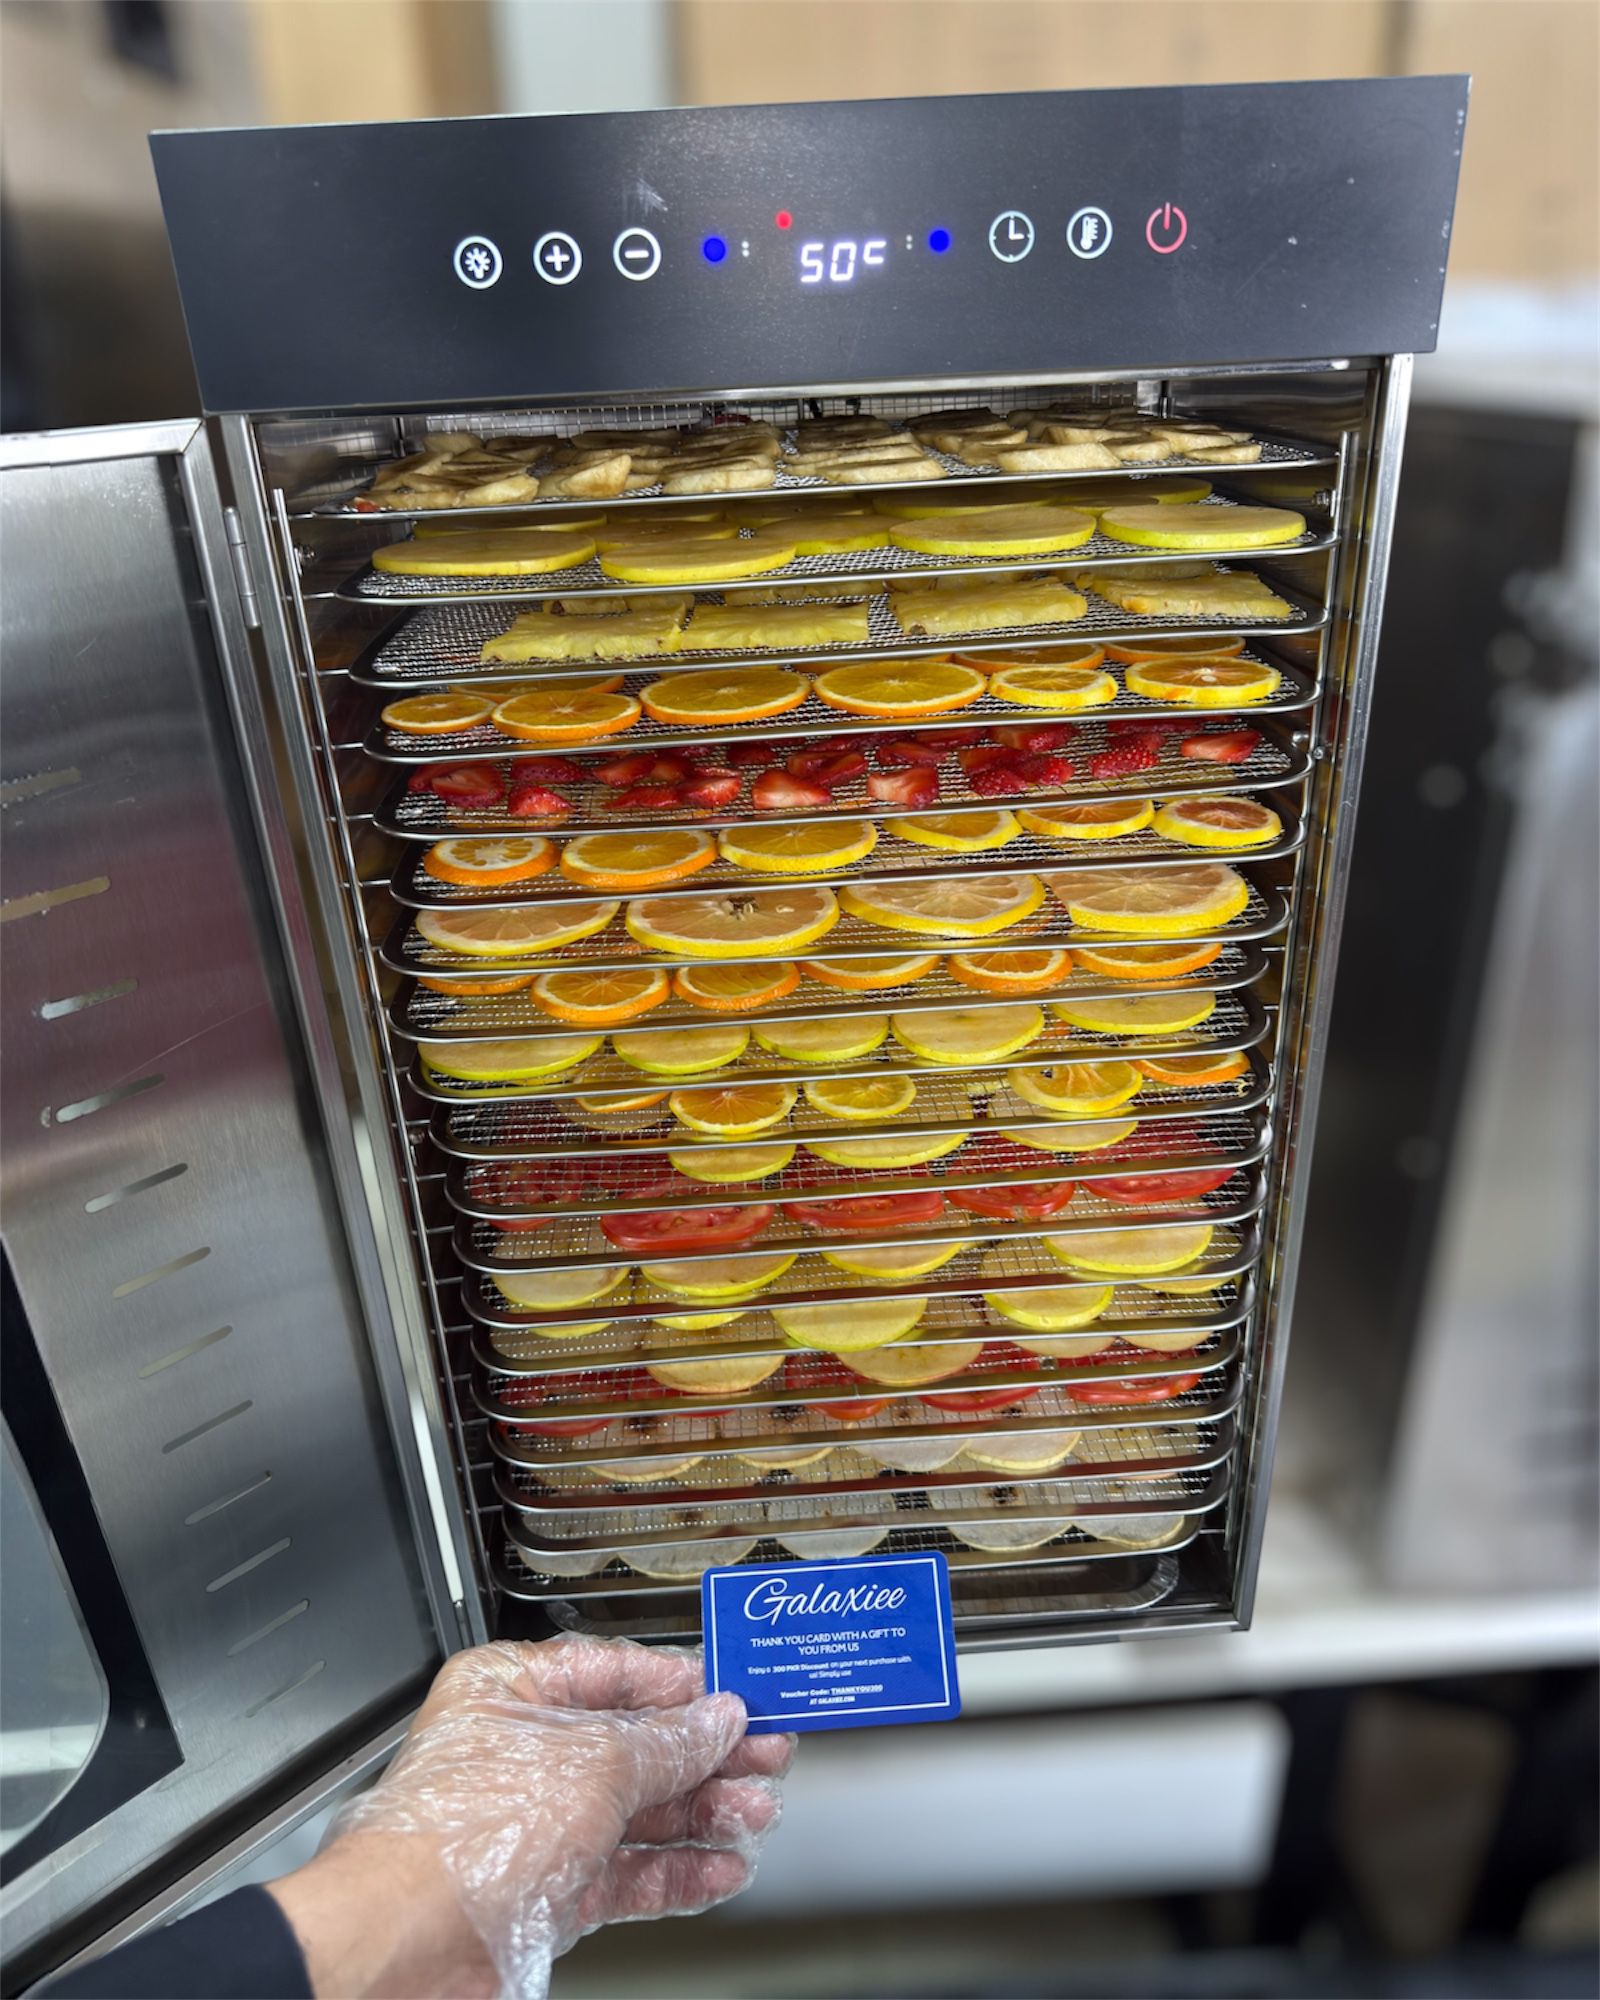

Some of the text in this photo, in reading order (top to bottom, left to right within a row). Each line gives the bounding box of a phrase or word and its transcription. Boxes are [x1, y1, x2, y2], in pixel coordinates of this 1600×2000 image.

[743, 1578, 907, 1626] Galaxiee
[750, 1627, 906, 1648] THANK YOU CARD WITH A GIFT TO
[798, 1641, 860, 1656] YOU FROM US
[747, 1666, 766, 1675] Enjoy
[800, 1661, 829, 1671] Discount
[839, 1660, 853, 1669] your
[853, 1658, 868, 1667] next
[868, 1656, 896, 1667] purchase
[780, 1690, 809, 1699] Voucher
